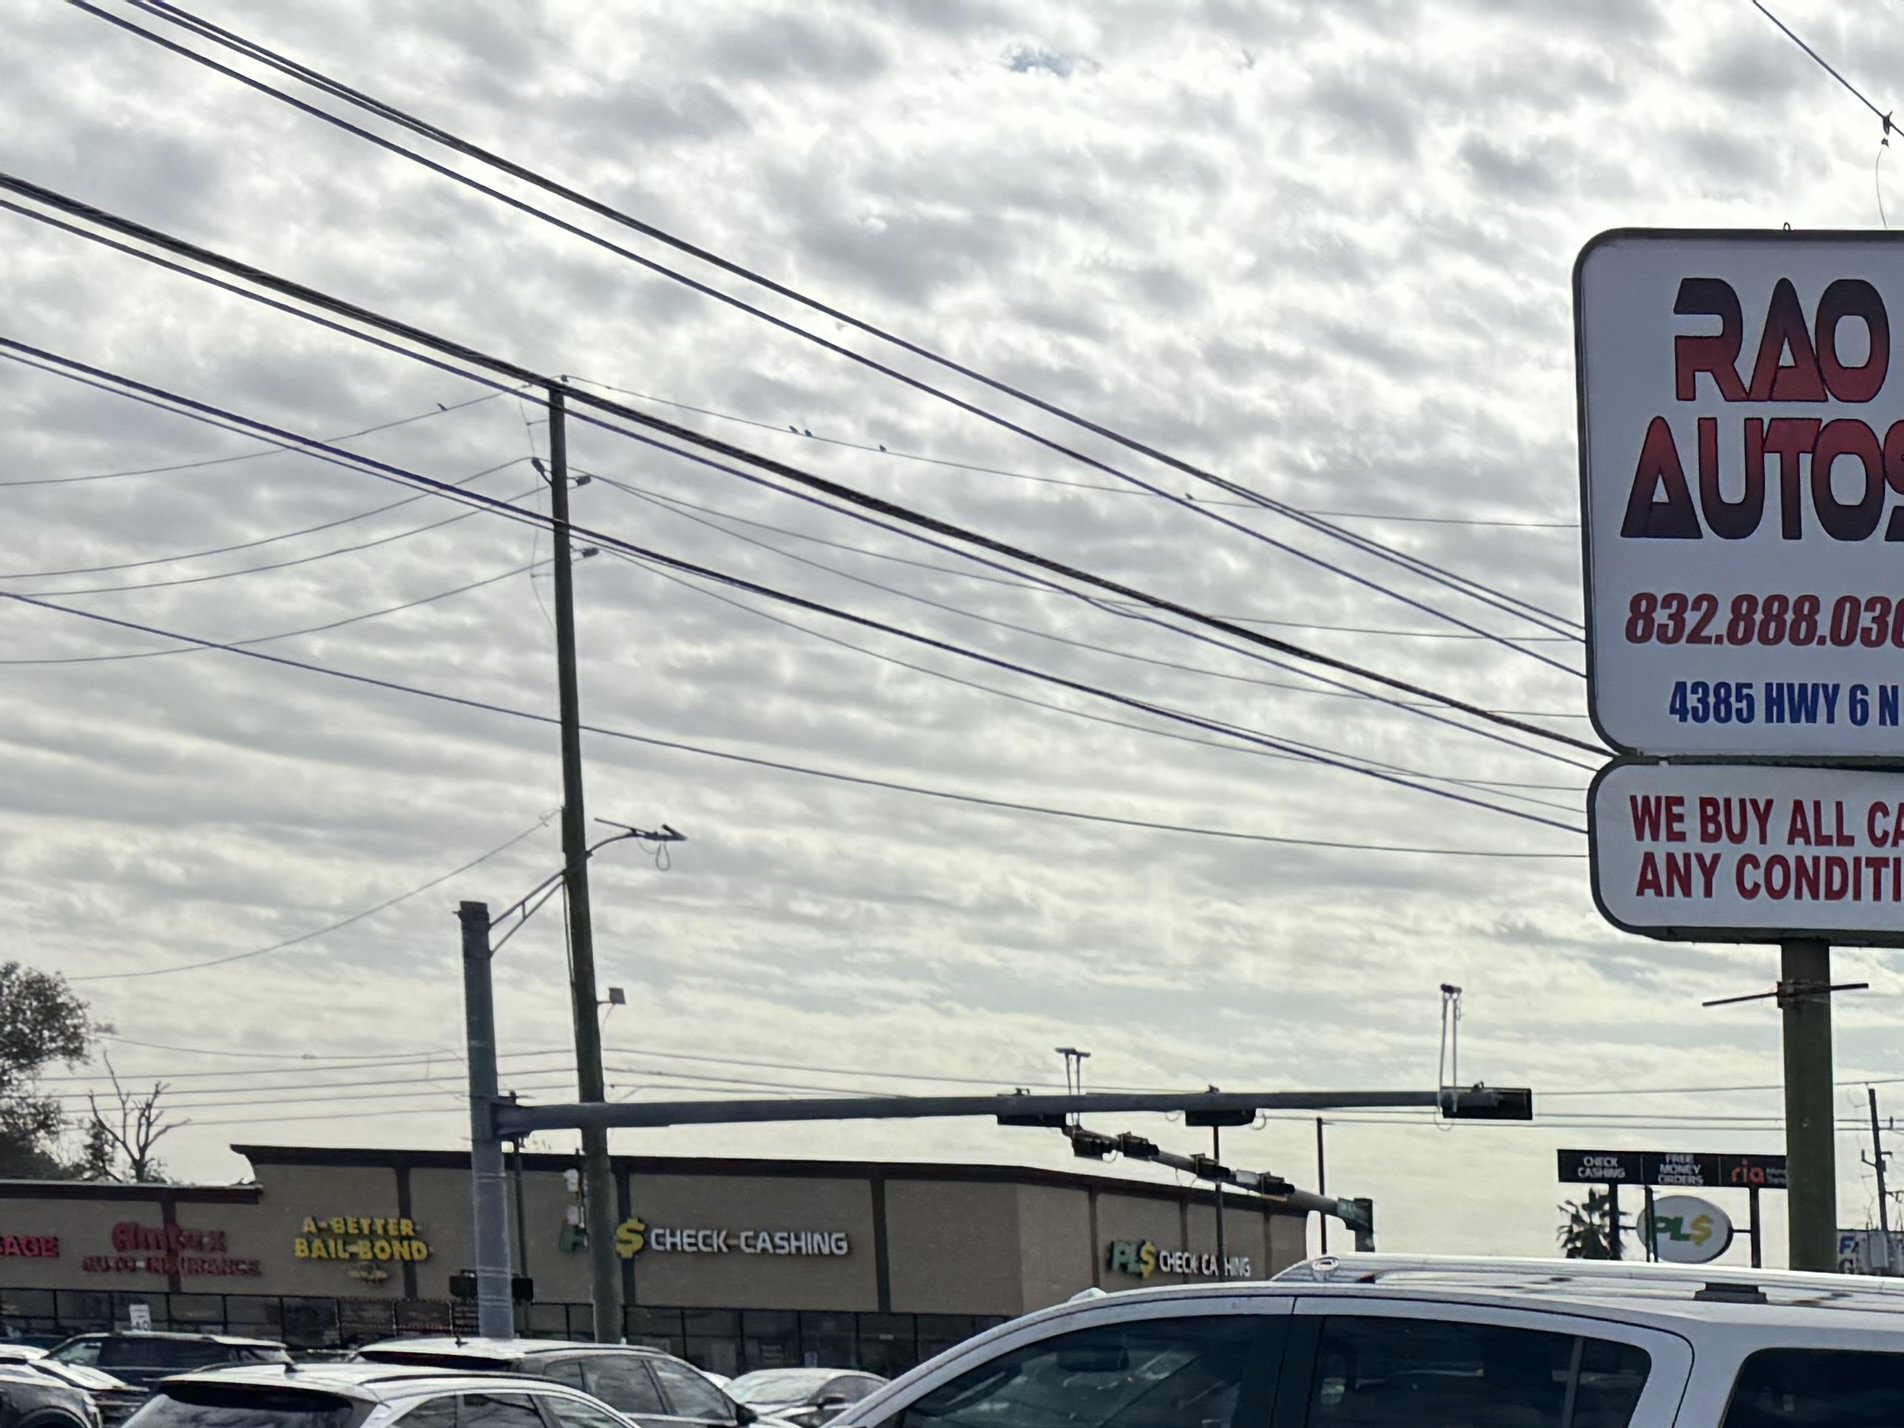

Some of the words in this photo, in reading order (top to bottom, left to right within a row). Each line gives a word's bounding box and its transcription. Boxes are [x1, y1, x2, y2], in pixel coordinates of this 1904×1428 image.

[1673, 277, 1890, 403] RAO
[1669, 681, 1753, 724] 4385
[1765, 682, 1842, 725] HWY
[1849, 684, 1870, 727] 6
[1629, 795, 1685, 843] WE
[1700, 797, 1774, 846] BUY
[1787, 800, 1855, 848] ALL
[1636, 853, 1722, 900] ANY
[1577, 1166, 1625, 1179] CASHING
[1583, 1156, 1619, 1168] CHECK
[1659, 1163, 1702, 1175] MONEY
[1731, 1159, 1766, 1185] ria
[650, 1228, 728, 1252] CHECK
[740, 1231, 849, 1256] CASHING
[1159, 1250, 1198, 1275] CHECK
[1201, 1252, 1251, 1278] CAHING
